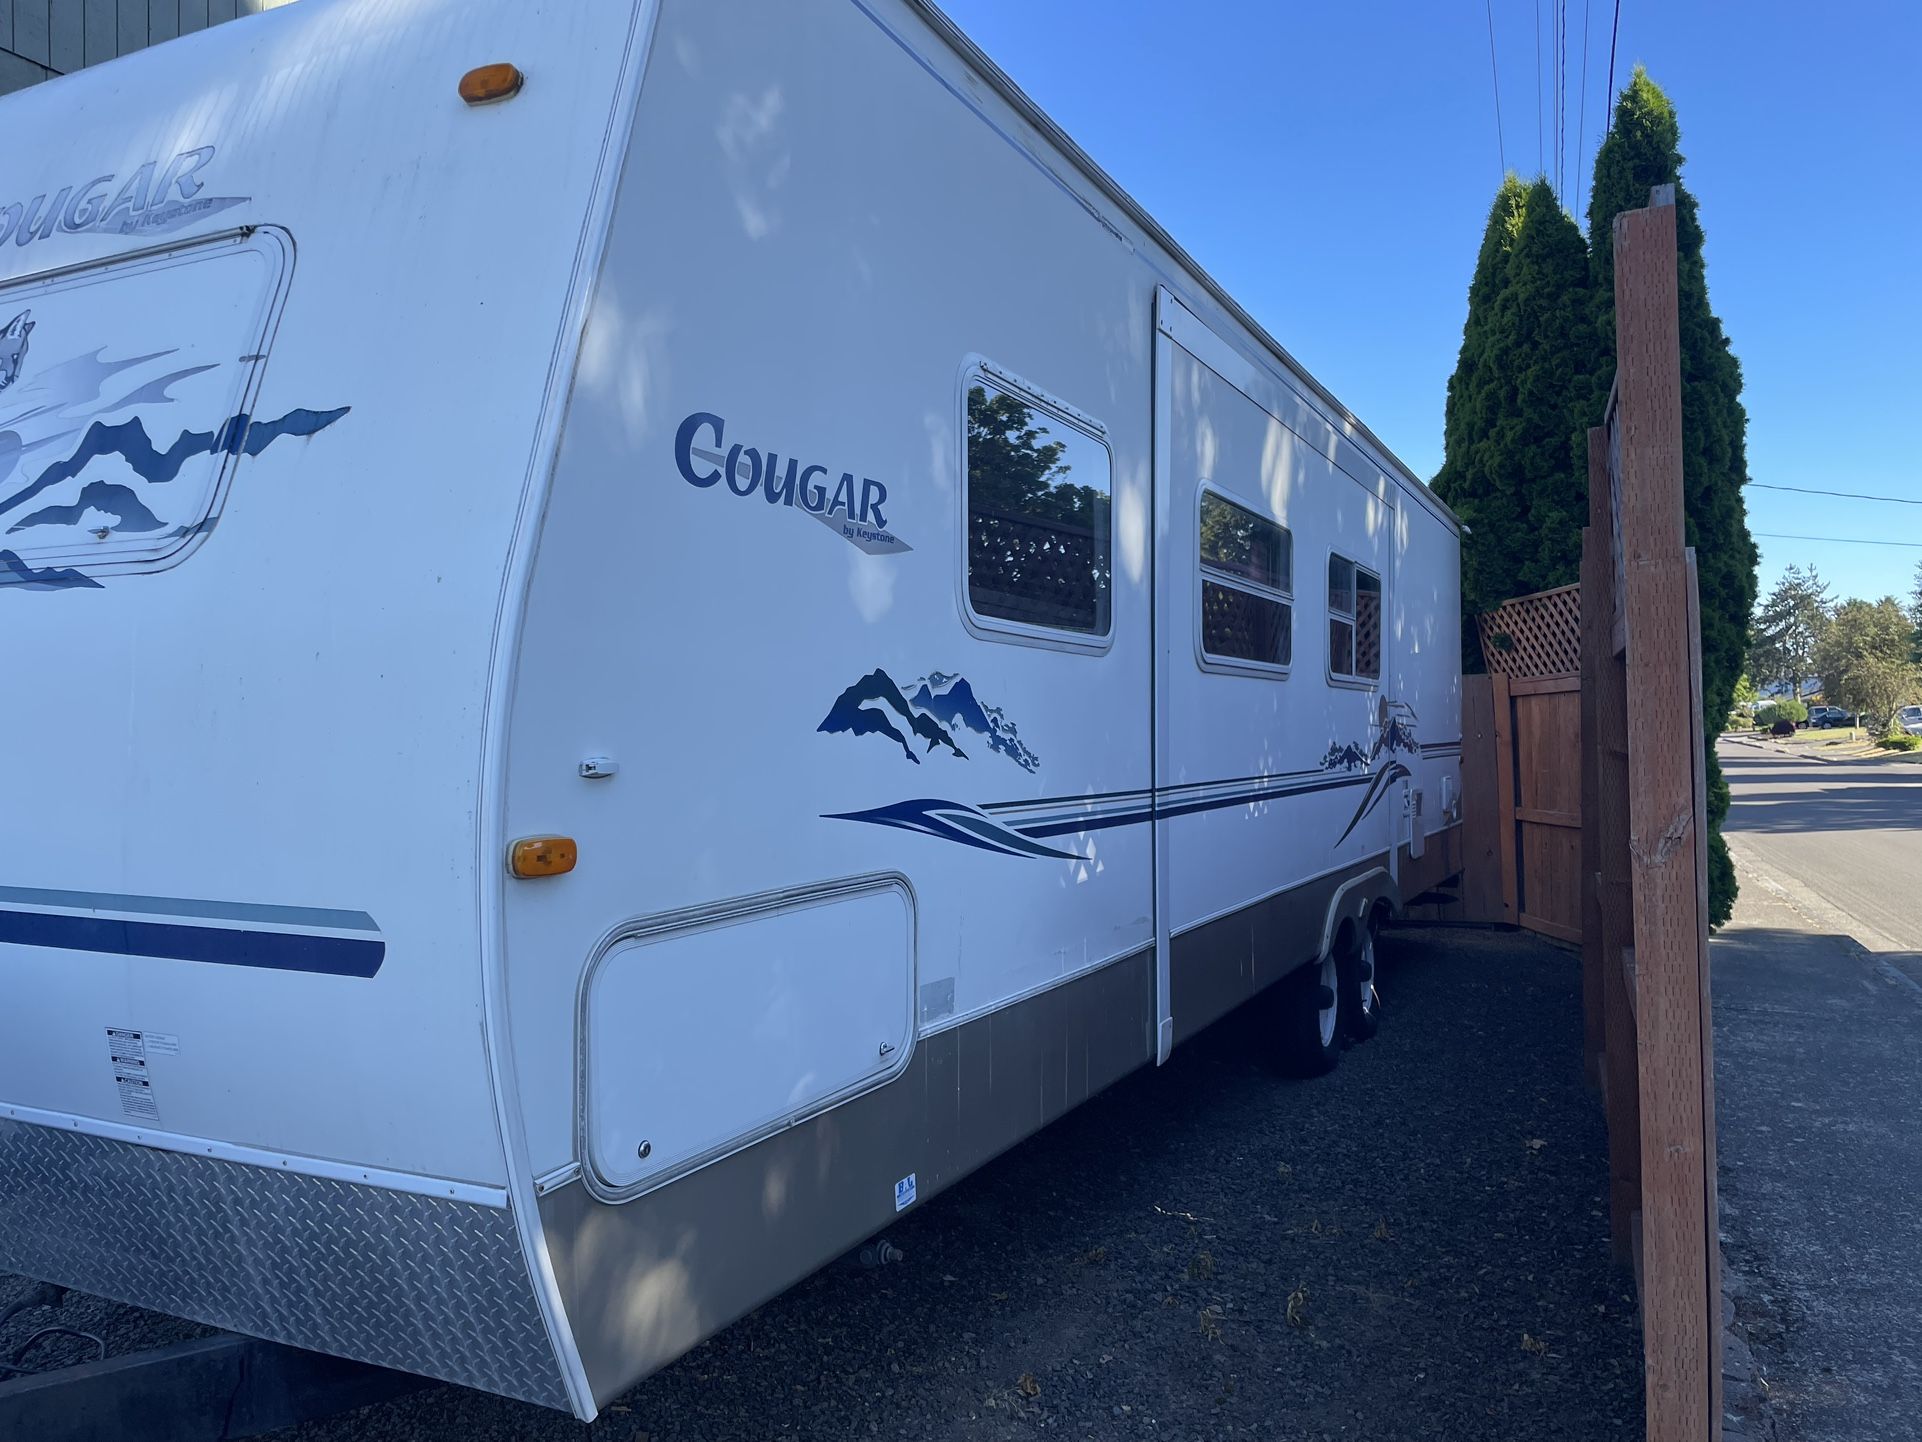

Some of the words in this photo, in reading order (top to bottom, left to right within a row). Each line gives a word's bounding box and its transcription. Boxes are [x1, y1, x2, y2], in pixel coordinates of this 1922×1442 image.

[674, 411, 888, 530] COUGAR
[842, 524, 855, 539] by
[856, 527, 895, 544] Keystone
